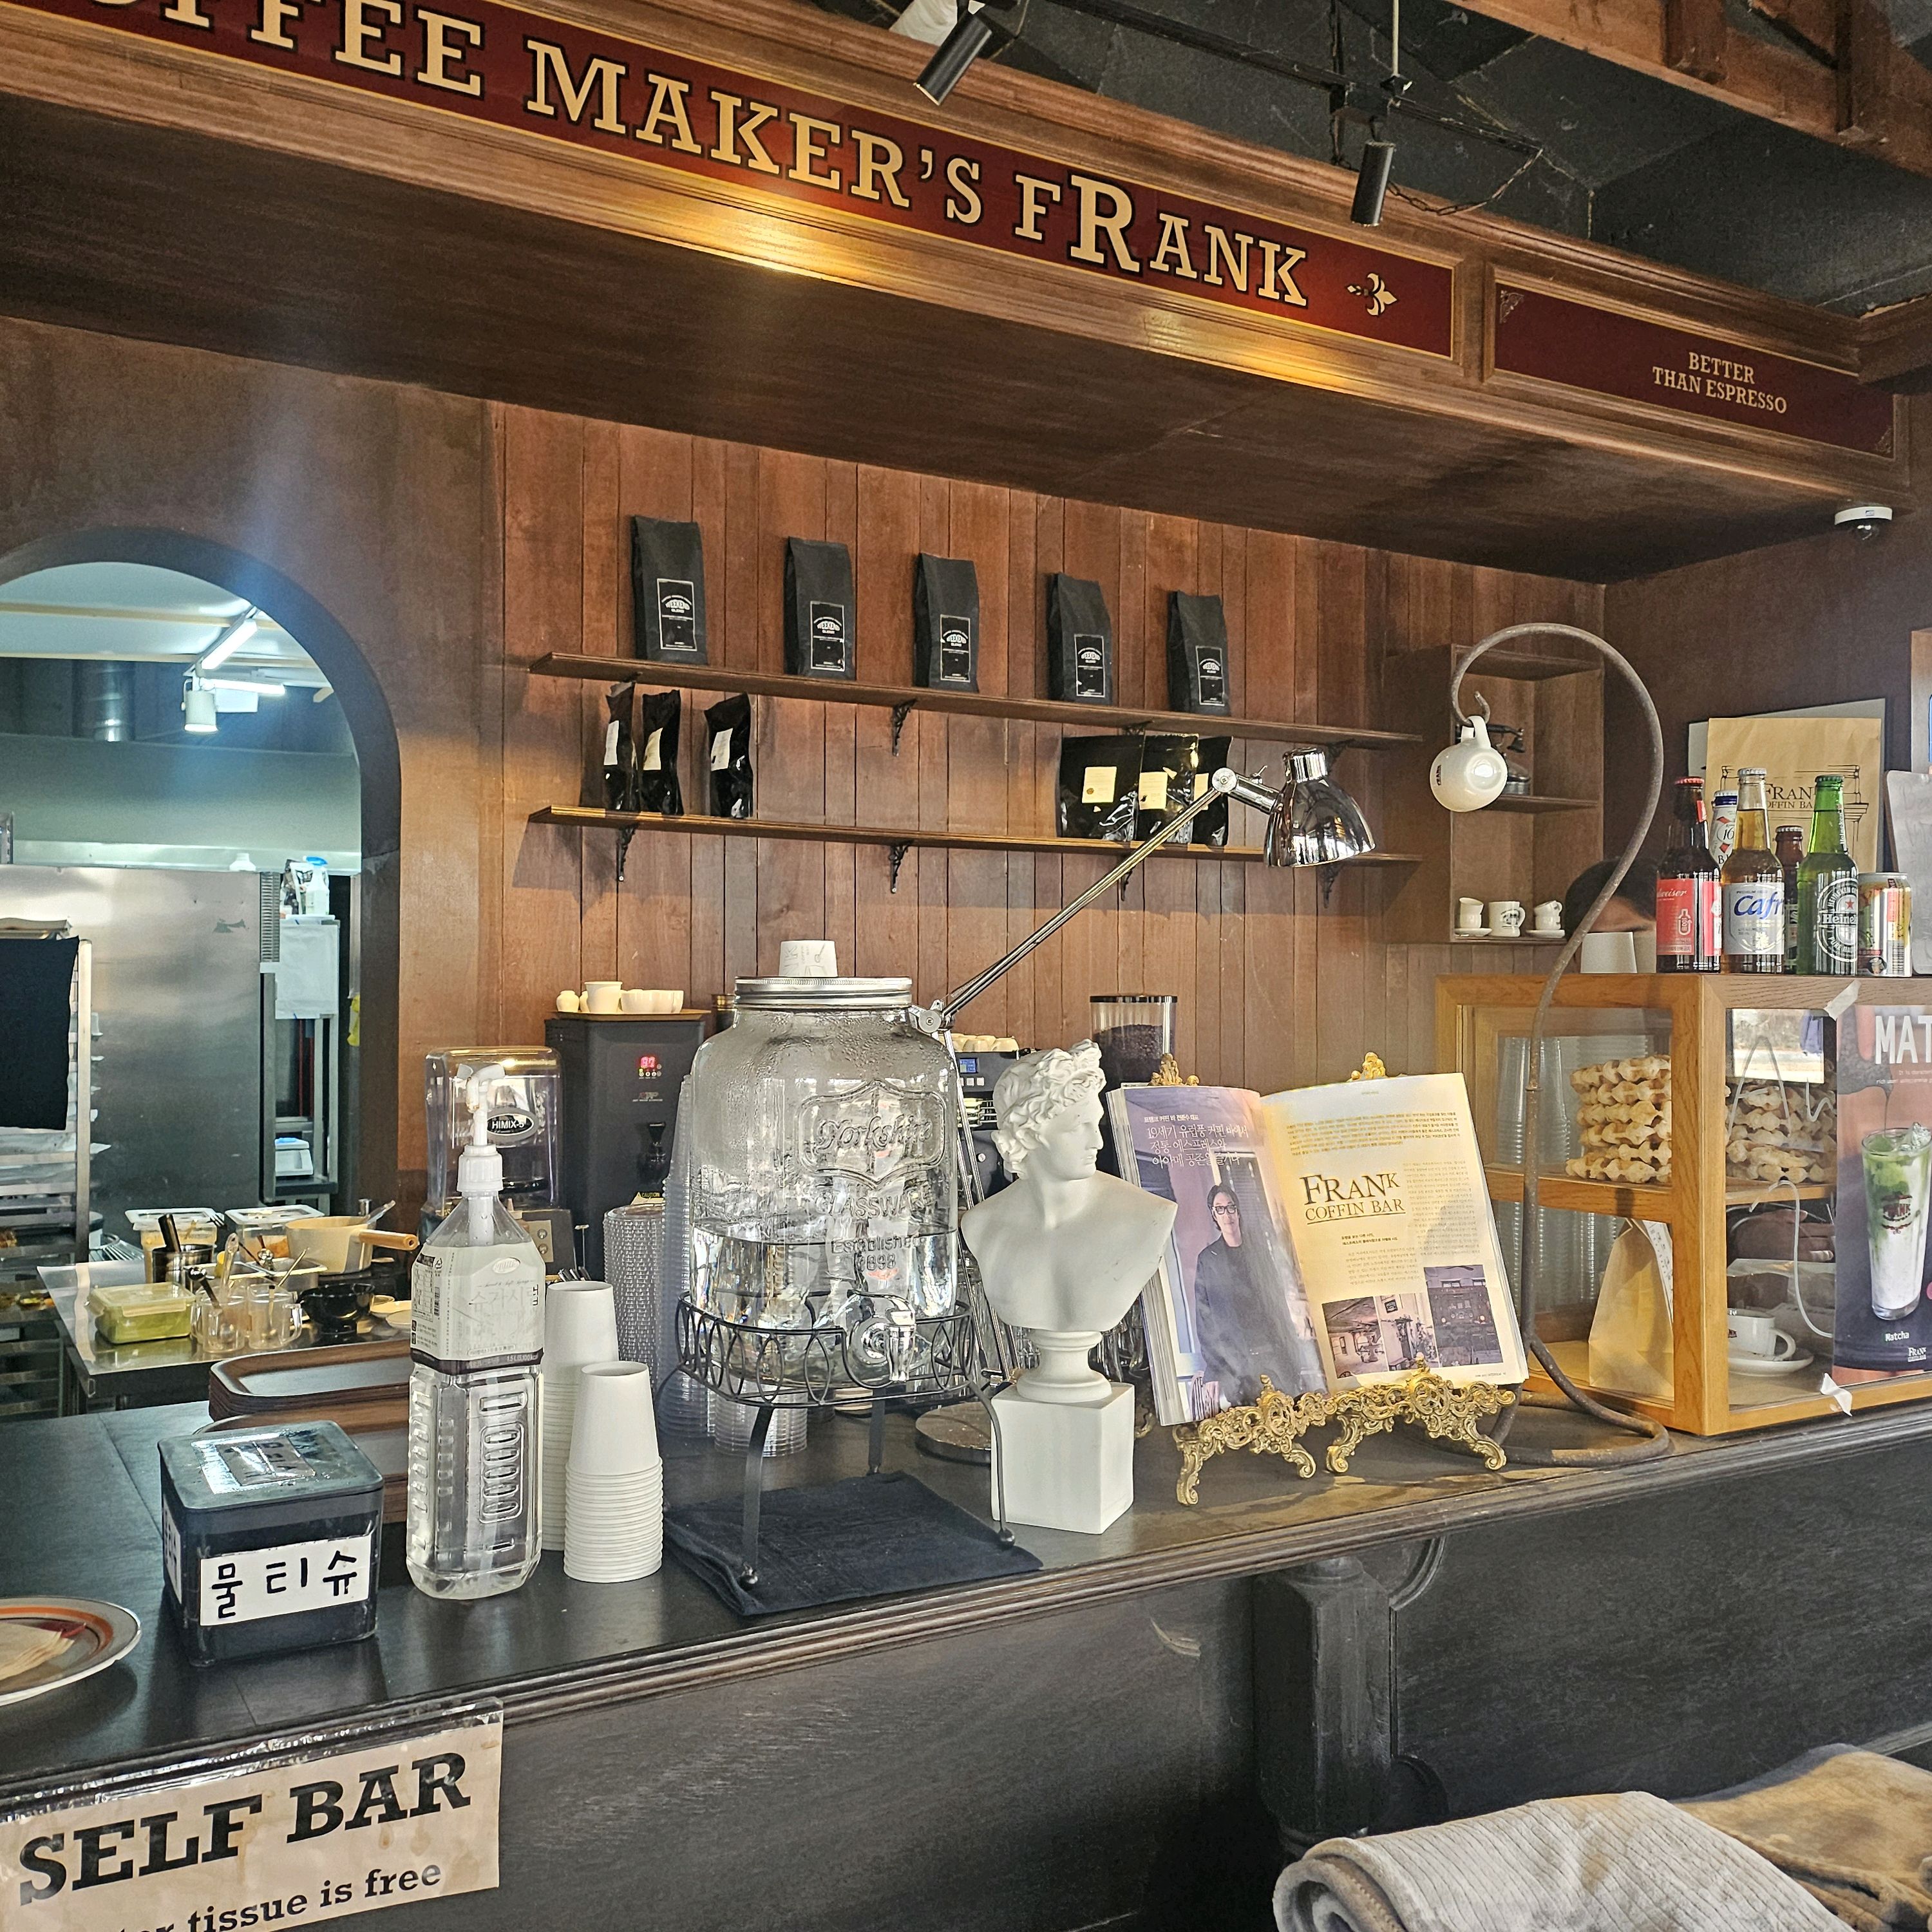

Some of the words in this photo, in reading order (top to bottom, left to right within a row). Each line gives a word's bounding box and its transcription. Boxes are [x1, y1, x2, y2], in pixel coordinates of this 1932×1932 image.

[93, 0, 481, 96] FEE
[526, 39, 981, 223] MAKER'S
[1014, 174, 1307, 307] FRANK
[1689, 352, 1755, 384] BETTER
[1653, 366, 1701, 393] THAN
[1706, 379, 1787, 413] ESPRESSO
[1723, 827, 1734, 840] 16
[492, 1120, 524, 1129] HIMIX-5
[1148, 1125, 1177, 1139] 19세기
[1179, 1124, 1206, 1138] 유럽풍
[1208, 1124, 1226, 1137] 커핀
[1150, 1140, 1171, 1154] 정통
[1300, 1173, 1400, 1206] FRANK
[1305, 1202, 1365, 1221] COFFIN
[1370, 1198, 1405, 1213] BAR
[1885, 1331, 1909, 1341] Matcha
[20, 1793, 262, 1906] SELF
[287, 1752, 471, 1843] BAR
[187, 1895, 308, 1932] tissue
[320, 1880, 352, 1908] is
[365, 1864, 442, 1898] free
